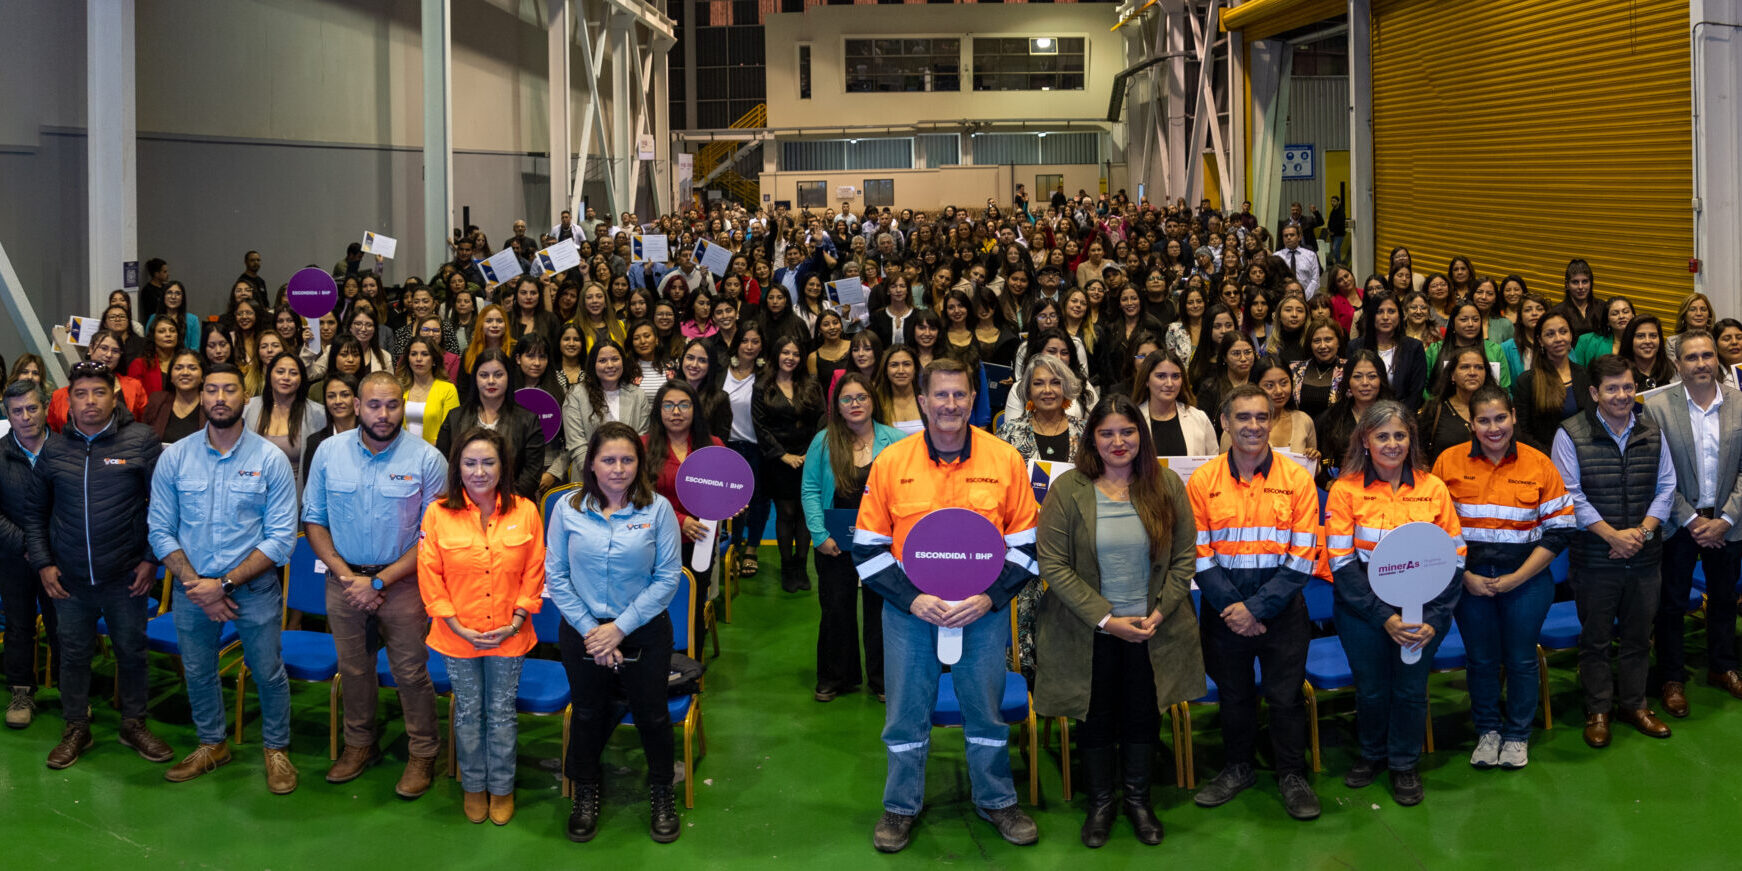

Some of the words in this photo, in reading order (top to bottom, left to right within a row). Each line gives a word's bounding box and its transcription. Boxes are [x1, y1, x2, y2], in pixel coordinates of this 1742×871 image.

[685, 475, 724, 487] ESCONDIDA
[915, 551, 966, 559] ESCONDIDA
[975, 552, 993, 560] BHP
[1378, 560, 1420, 572] minerAs
